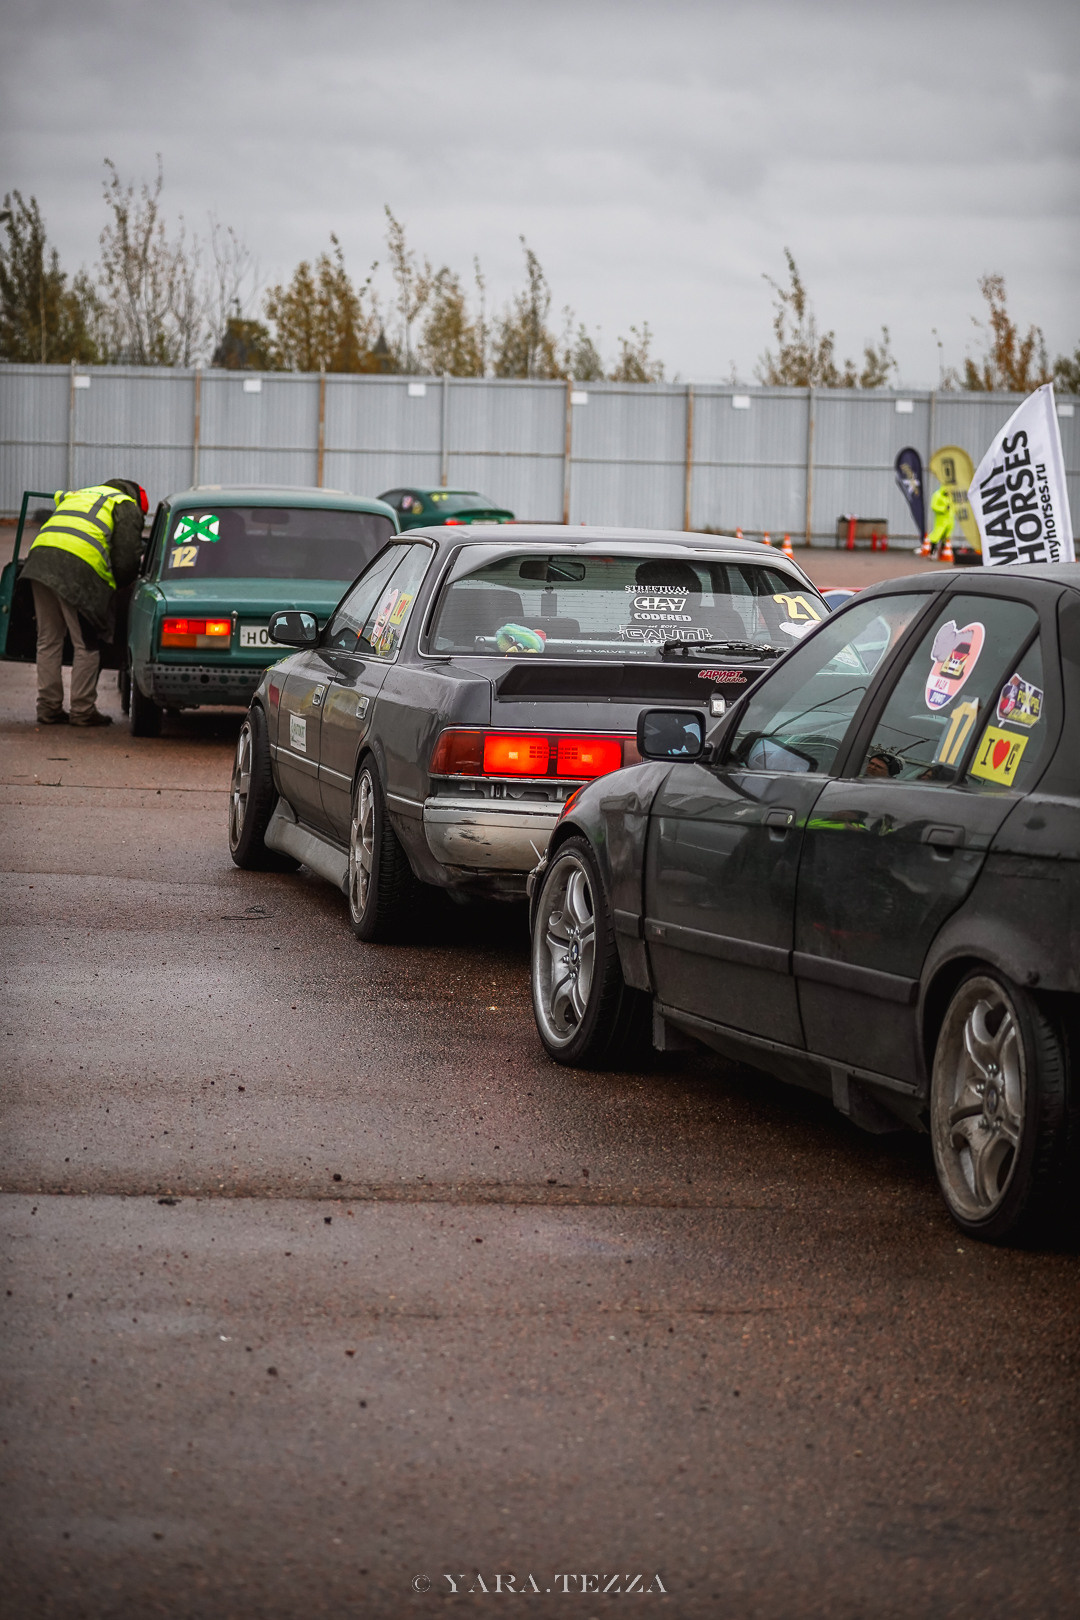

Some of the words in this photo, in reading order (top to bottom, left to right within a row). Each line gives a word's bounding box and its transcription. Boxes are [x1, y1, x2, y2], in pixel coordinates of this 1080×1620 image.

[1003, 431, 1047, 565] HORSES
[980, 466, 1018, 566] MANY
[171, 546, 198, 568] 12
[633, 612, 692, 622] CODERED
[773, 594, 821, 621] 21
